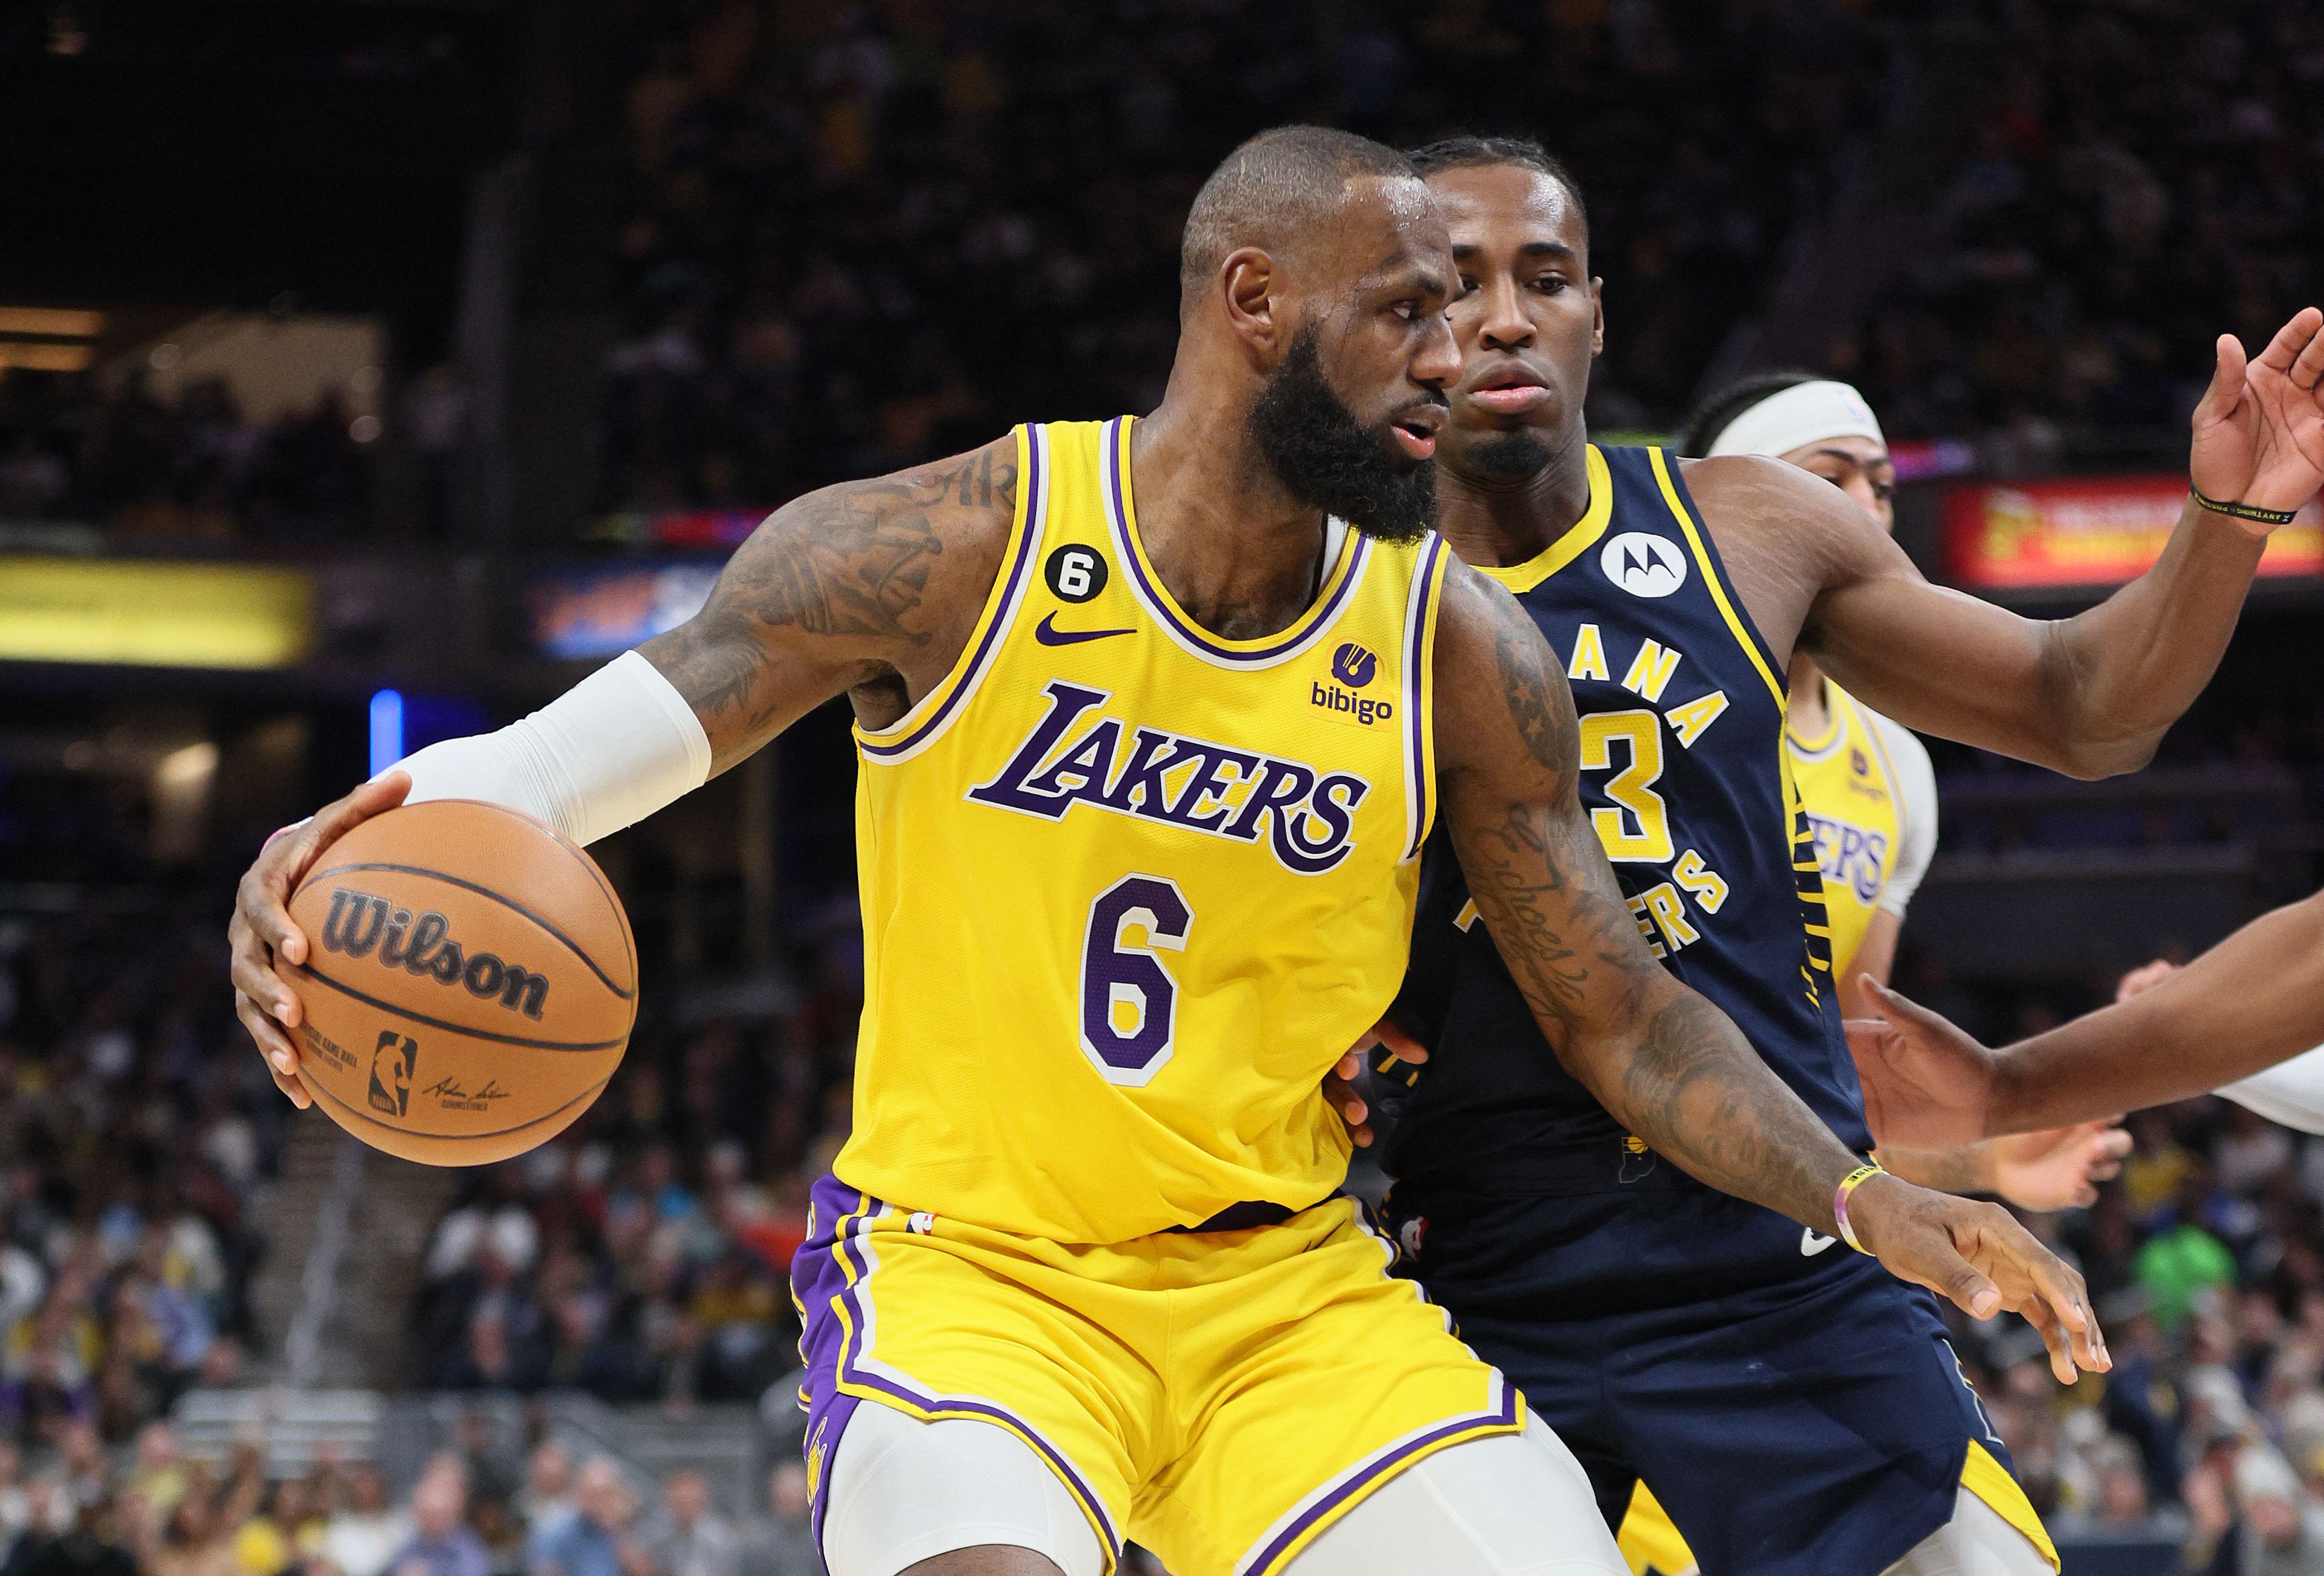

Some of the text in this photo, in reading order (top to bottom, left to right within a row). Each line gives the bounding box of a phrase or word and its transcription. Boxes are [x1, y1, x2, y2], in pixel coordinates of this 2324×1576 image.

[1058, 551, 1094, 597] 6
[1311, 680, 1392, 725] bibigo
[963, 678, 1373, 877] LAKERS
[321, 887, 549, 1023] Wilson
[1078, 871, 1196, 1088] 6
